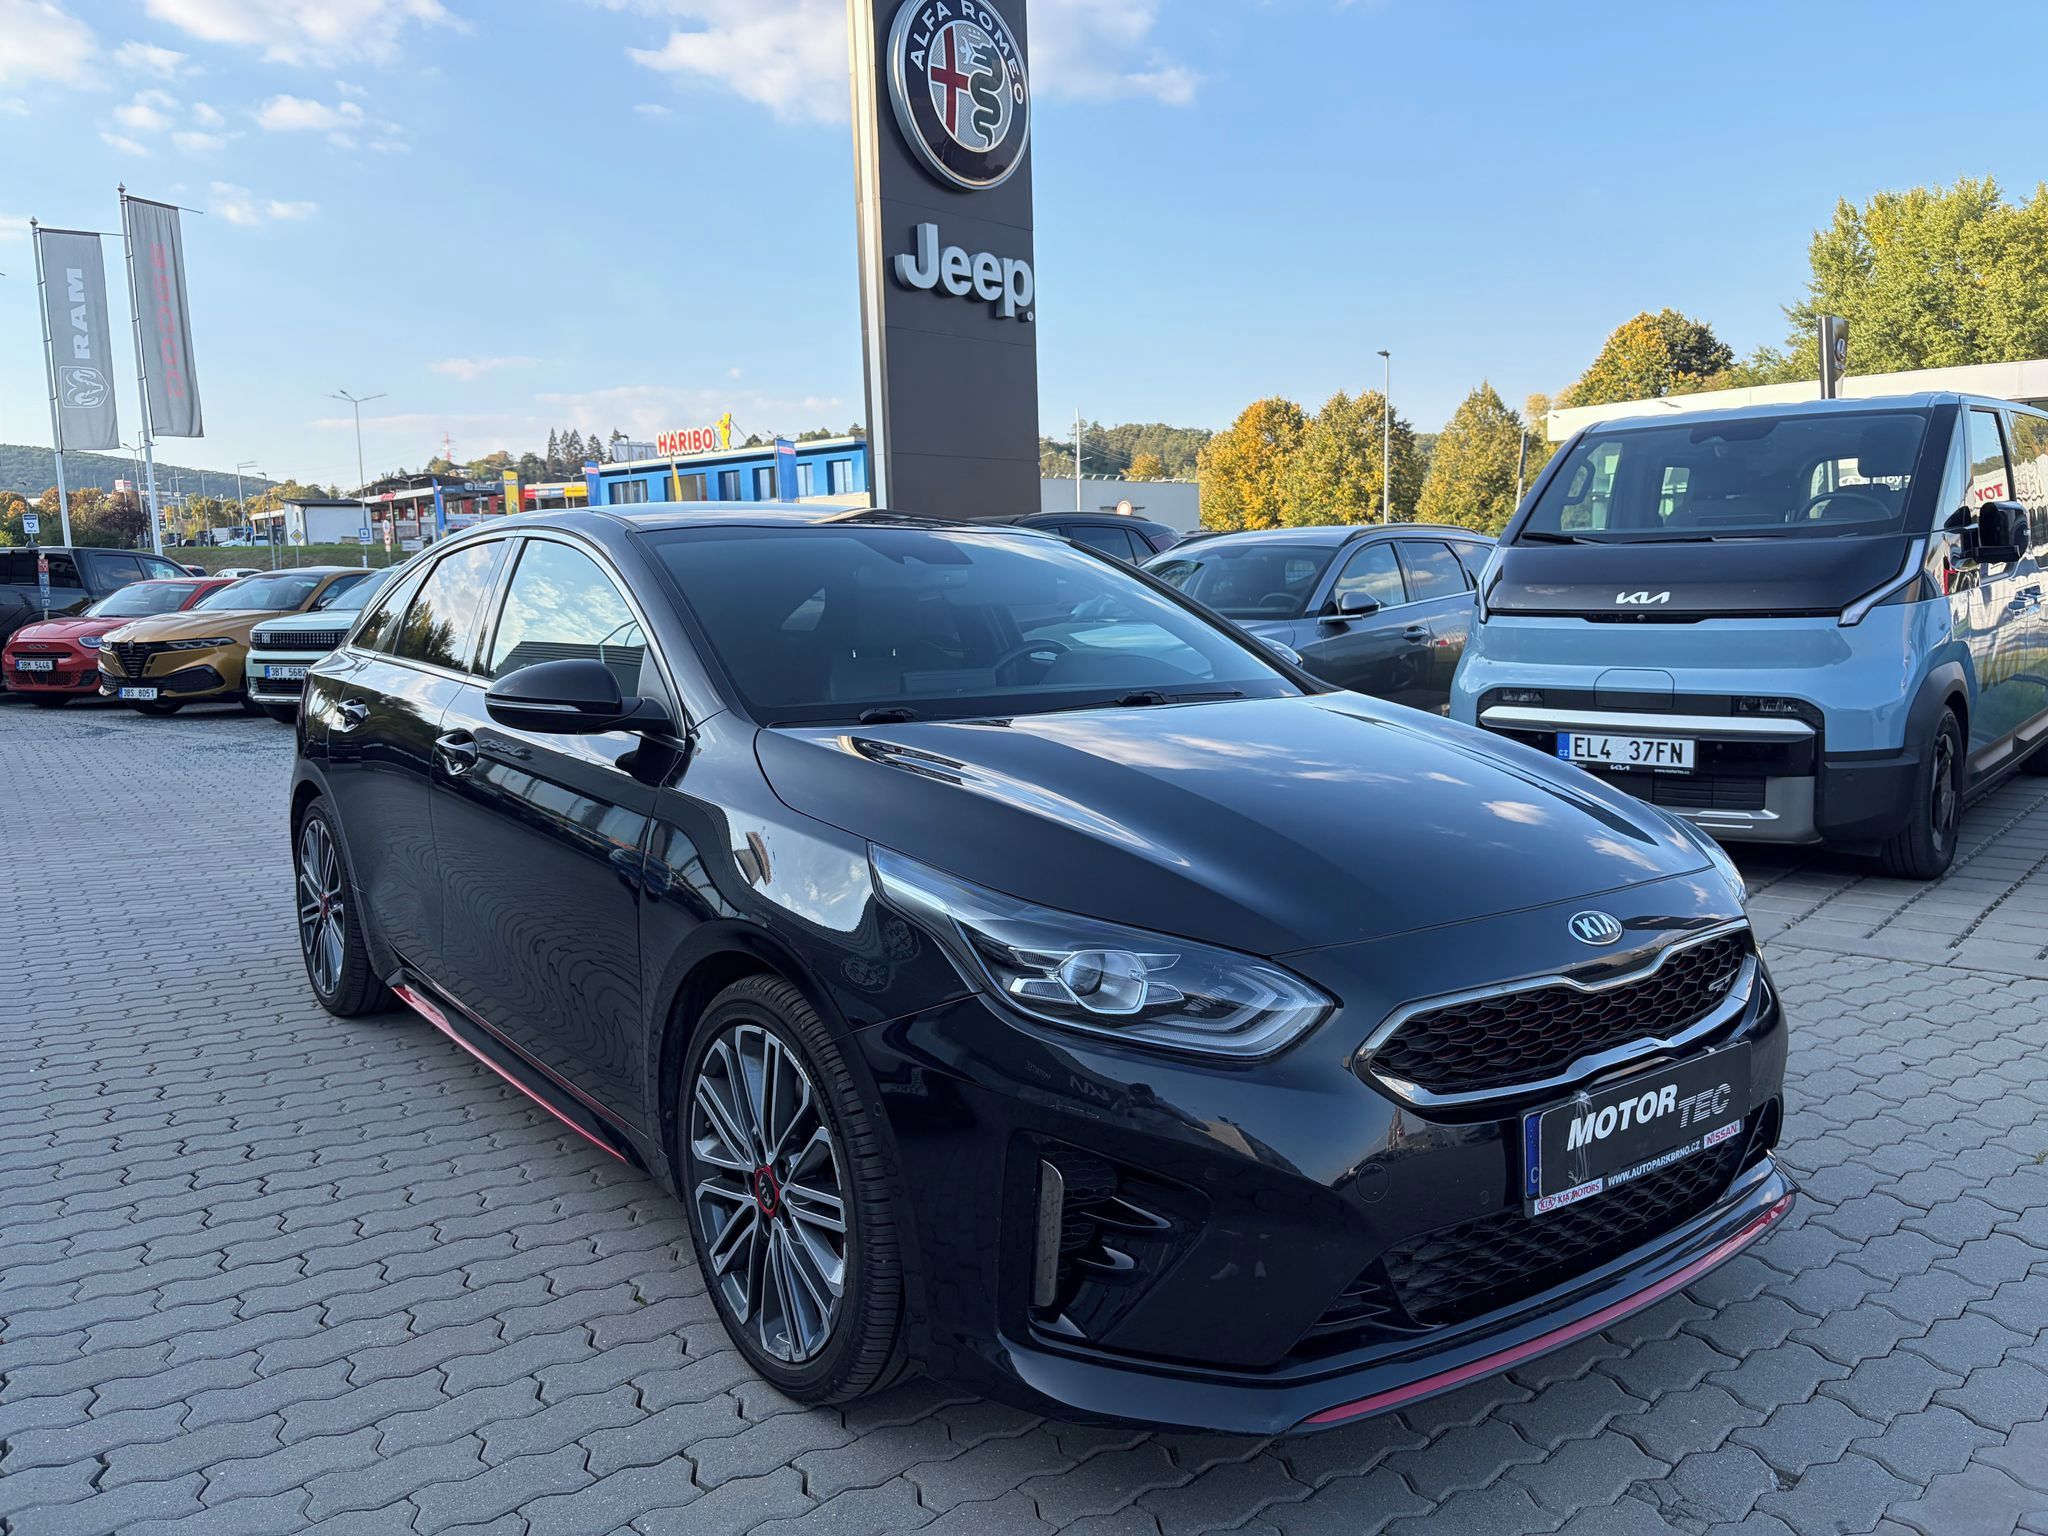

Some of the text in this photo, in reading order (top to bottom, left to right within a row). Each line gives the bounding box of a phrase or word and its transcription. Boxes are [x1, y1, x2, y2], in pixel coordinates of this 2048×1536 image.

[910, 1, 1023, 105] ALFA ROMEO
[894, 222, 1034, 318] Jeep
[66, 267, 91, 360] RAM
[657, 427, 714, 456] HARIBO
[1615, 591, 1671, 604] KIA
[271, 667, 307, 677] 3BT 5682
[138, 688, 155, 698] 8051
[1558, 737, 1683, 764] CZ EL4 37FN
[1574, 914, 1619, 939] KIA
[1567, 1083, 1732, 1152] MOTOR TEC
[1557, 1193, 1570, 1204] KIA
[1571, 1182, 1600, 1201] MOTORS
[1607, 1140, 1701, 1187] WWW.AUTOPARKBRNO.CZ
[1706, 1123, 1738, 1146] NISSAN
